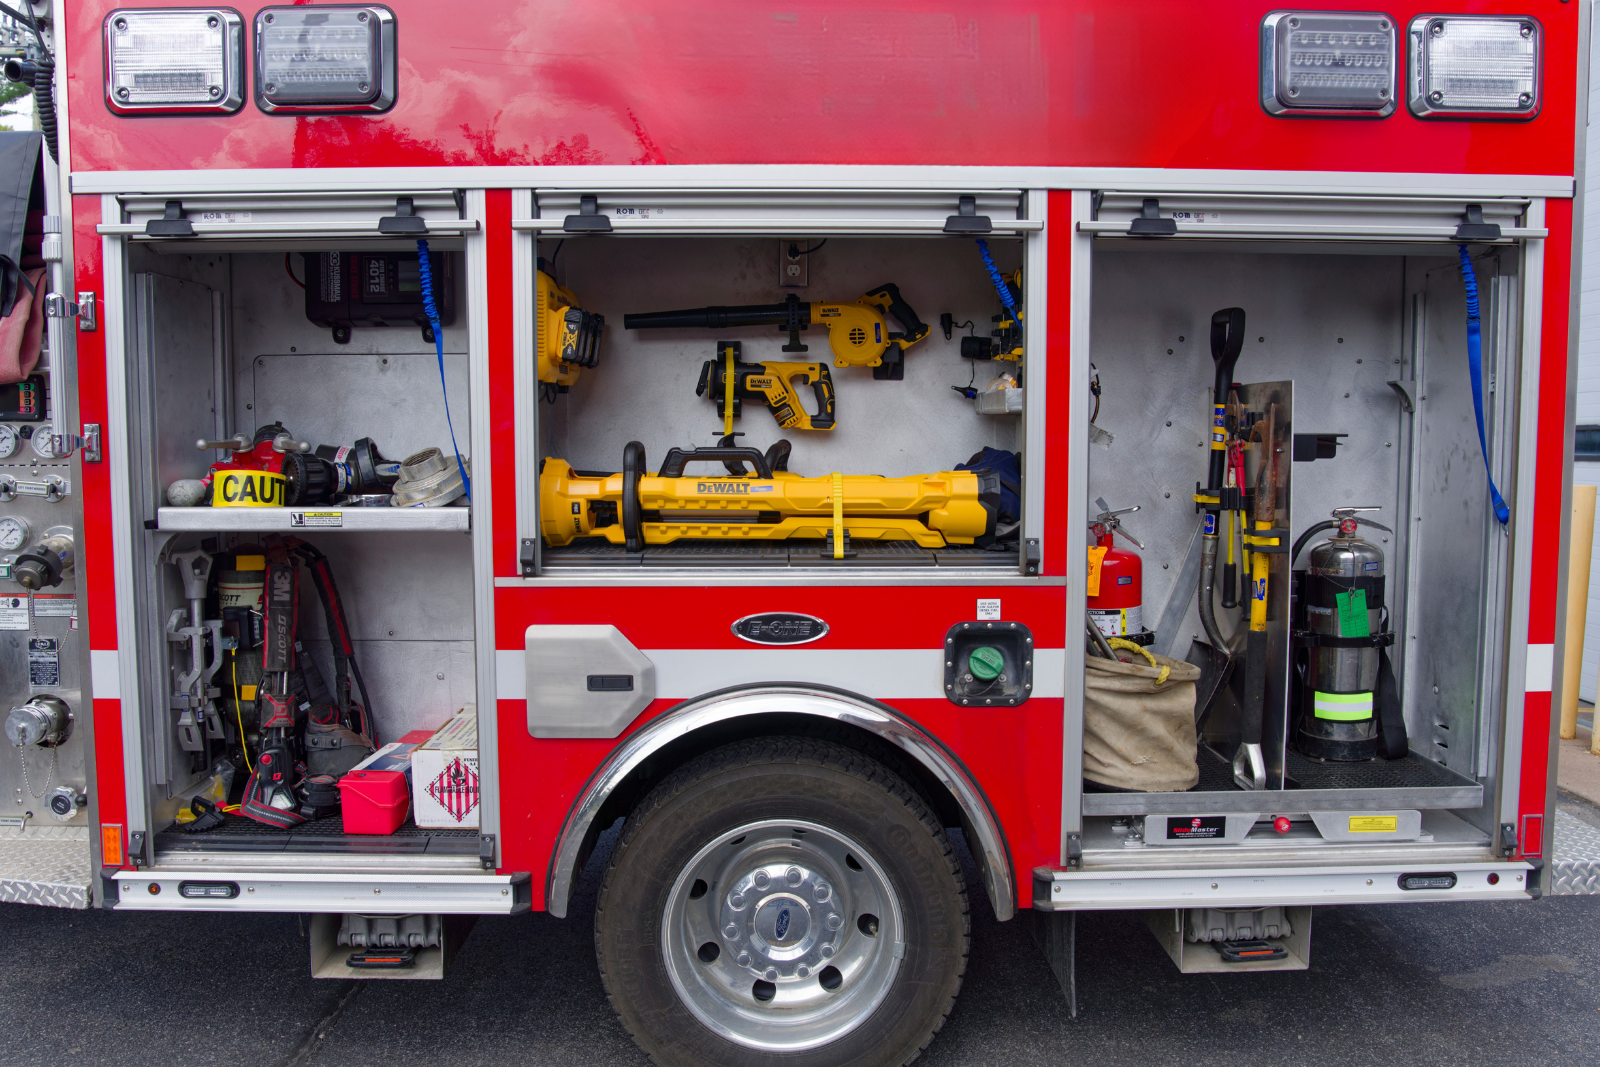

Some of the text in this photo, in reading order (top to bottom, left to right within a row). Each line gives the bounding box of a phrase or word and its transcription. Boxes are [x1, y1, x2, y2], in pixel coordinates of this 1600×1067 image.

[370, 260, 379, 292] 4012
[223, 475, 284, 504] CAUT
[219, 594, 242, 602] SCOTT
[273, 570, 291, 601] 3M
[747, 620, 813, 636] E-ONE
[277, 624, 287, 663] SCOTT
[777, 914, 788, 933] Ford
